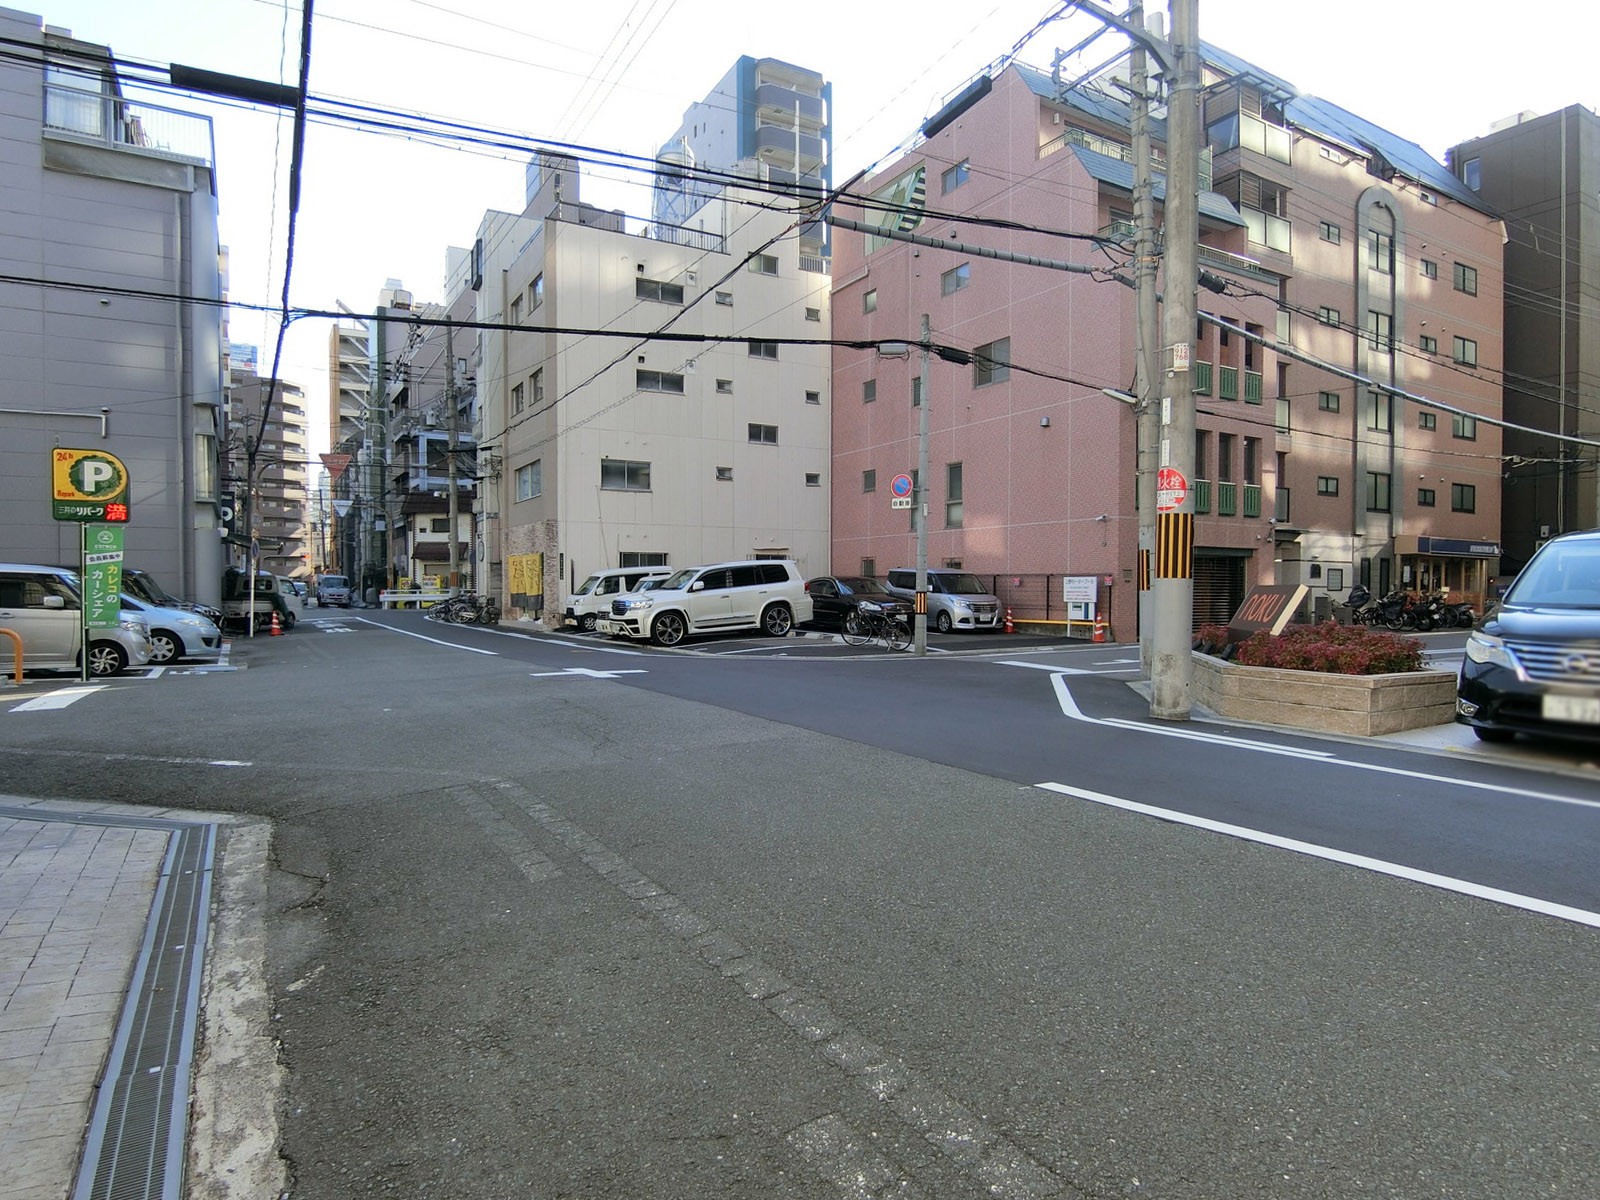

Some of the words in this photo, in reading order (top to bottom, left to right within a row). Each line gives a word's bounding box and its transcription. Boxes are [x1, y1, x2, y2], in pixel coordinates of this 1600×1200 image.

[83, 461, 113, 492] P
[91, 570, 105, 618] カーシェア
[106, 564, 119, 604] カレコの
